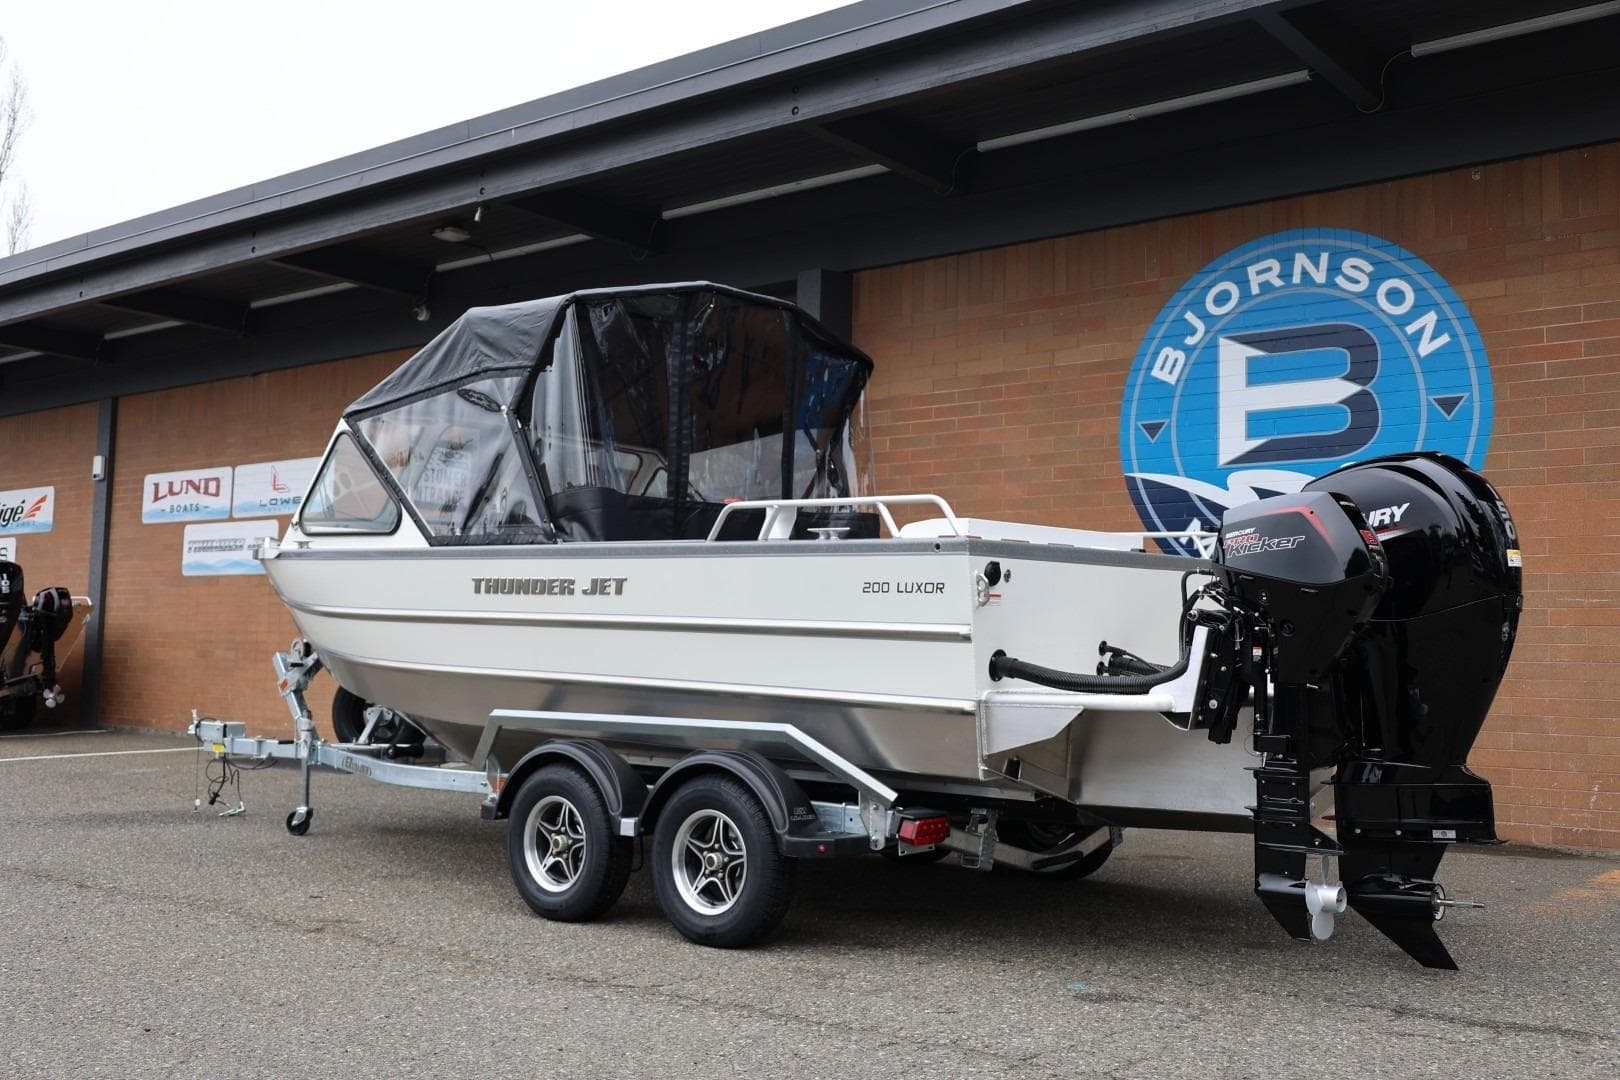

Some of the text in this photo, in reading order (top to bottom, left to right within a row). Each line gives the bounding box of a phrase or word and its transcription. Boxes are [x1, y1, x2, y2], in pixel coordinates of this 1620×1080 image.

[1151, 252, 1451, 386] BJORNSON
[152, 477, 221, 503] LUND
[0, 499, 26, 528] igé
[169, 503, 200, 514] BOATS
[1225, 527, 1256, 539] MERCURY
[472, 577, 628, 596] THUNDER JET
[862, 582, 945, 594] 200 LUXOR
